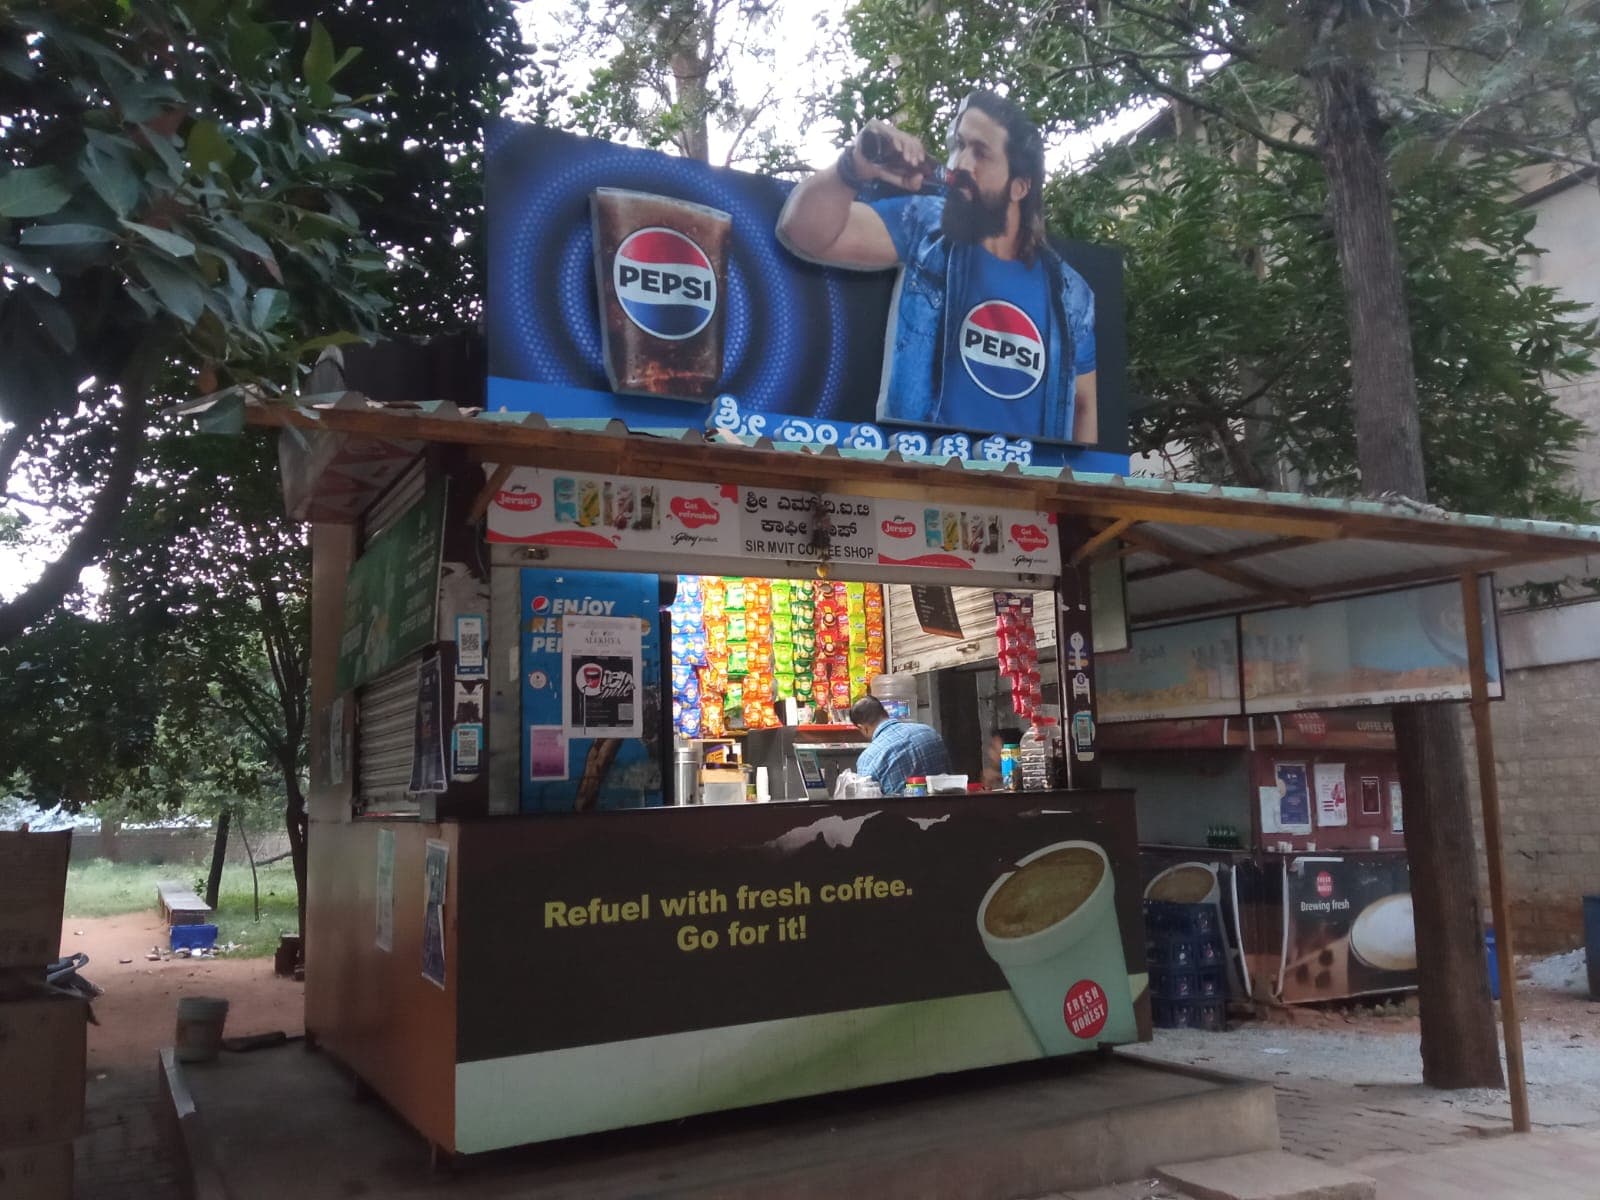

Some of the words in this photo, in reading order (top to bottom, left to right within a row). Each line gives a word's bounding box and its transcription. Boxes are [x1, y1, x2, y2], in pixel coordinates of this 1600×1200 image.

[619, 264, 711, 301] PEPSI
[965, 328, 1040, 370] PEPSI
[745, 540, 765, 553] SIR
[768, 541, 795, 555] MVIT
[844, 546, 874, 559] SHOP
[552, 598, 616, 615] ENJOY
[544, 894, 649, 928] Refuel
[660, 889, 727, 917] with
[736, 881, 811, 910] fresh
[820, 876, 913, 903] coffee.
[1300, 901, 1330, 912] Brewing
[1332, 899, 1350, 910] fresh
[677, 925, 719, 951] Go
[728, 921, 769, 946] for
[778, 915, 806, 942] it!
[1066, 986, 1099, 1015] FRESH
[1072, 1004, 1105, 1034] HONEST
